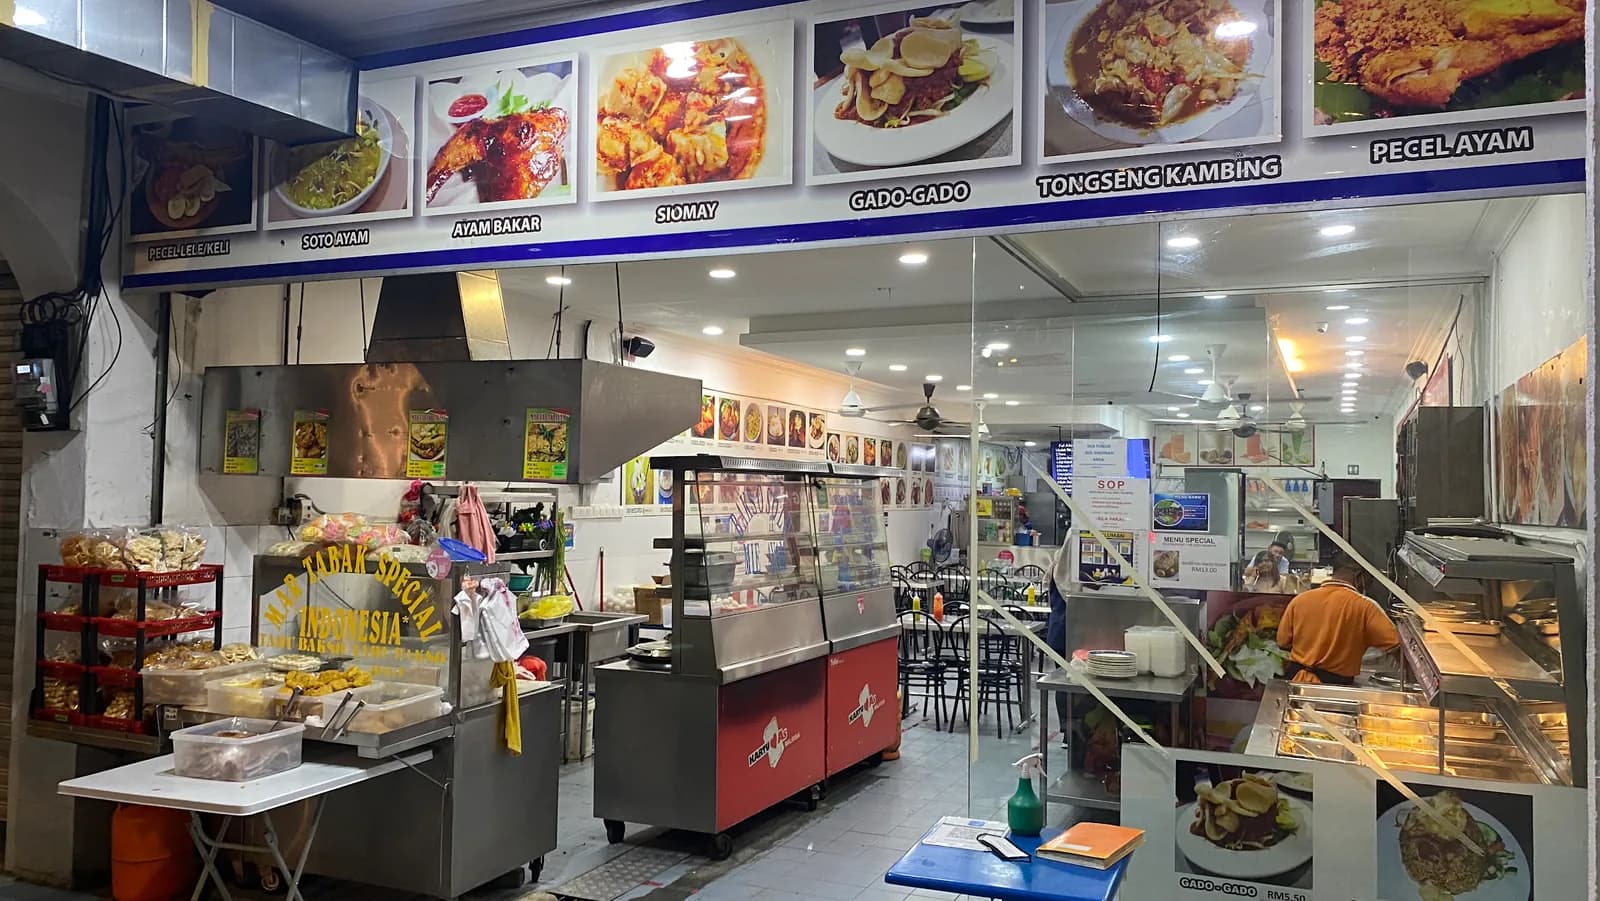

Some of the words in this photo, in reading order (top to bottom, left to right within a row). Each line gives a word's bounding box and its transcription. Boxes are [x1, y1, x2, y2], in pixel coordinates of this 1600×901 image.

[1370, 134, 1449, 164] PECEL
[1453, 126, 1534, 156] AYAM
[1037, 166, 1161, 198] TONGSENG
[1164, 154, 1282, 187] KAMBING
[849, 181, 970, 211] GADO-GADO
[656, 201, 718, 223] SIOMAY
[452, 220, 490, 238] AYAM
[493, 215, 541, 234] BAKAR
[302, 232, 334, 250] SOTO
[334, 229, 369, 247] AYAM
[1097, 480, 1125, 489] SOP
[302, 544, 368, 584] TABAK
[375, 553, 443, 642] SPECIAL
[299, 606, 401, 646] INDONESIA
[748, 742, 770, 765] KARTU
[1180, 878, 1214, 891] GADO
[1222, 883, 1257, 897] GADO
[1267, 890, 1306, 901] RM5.50
